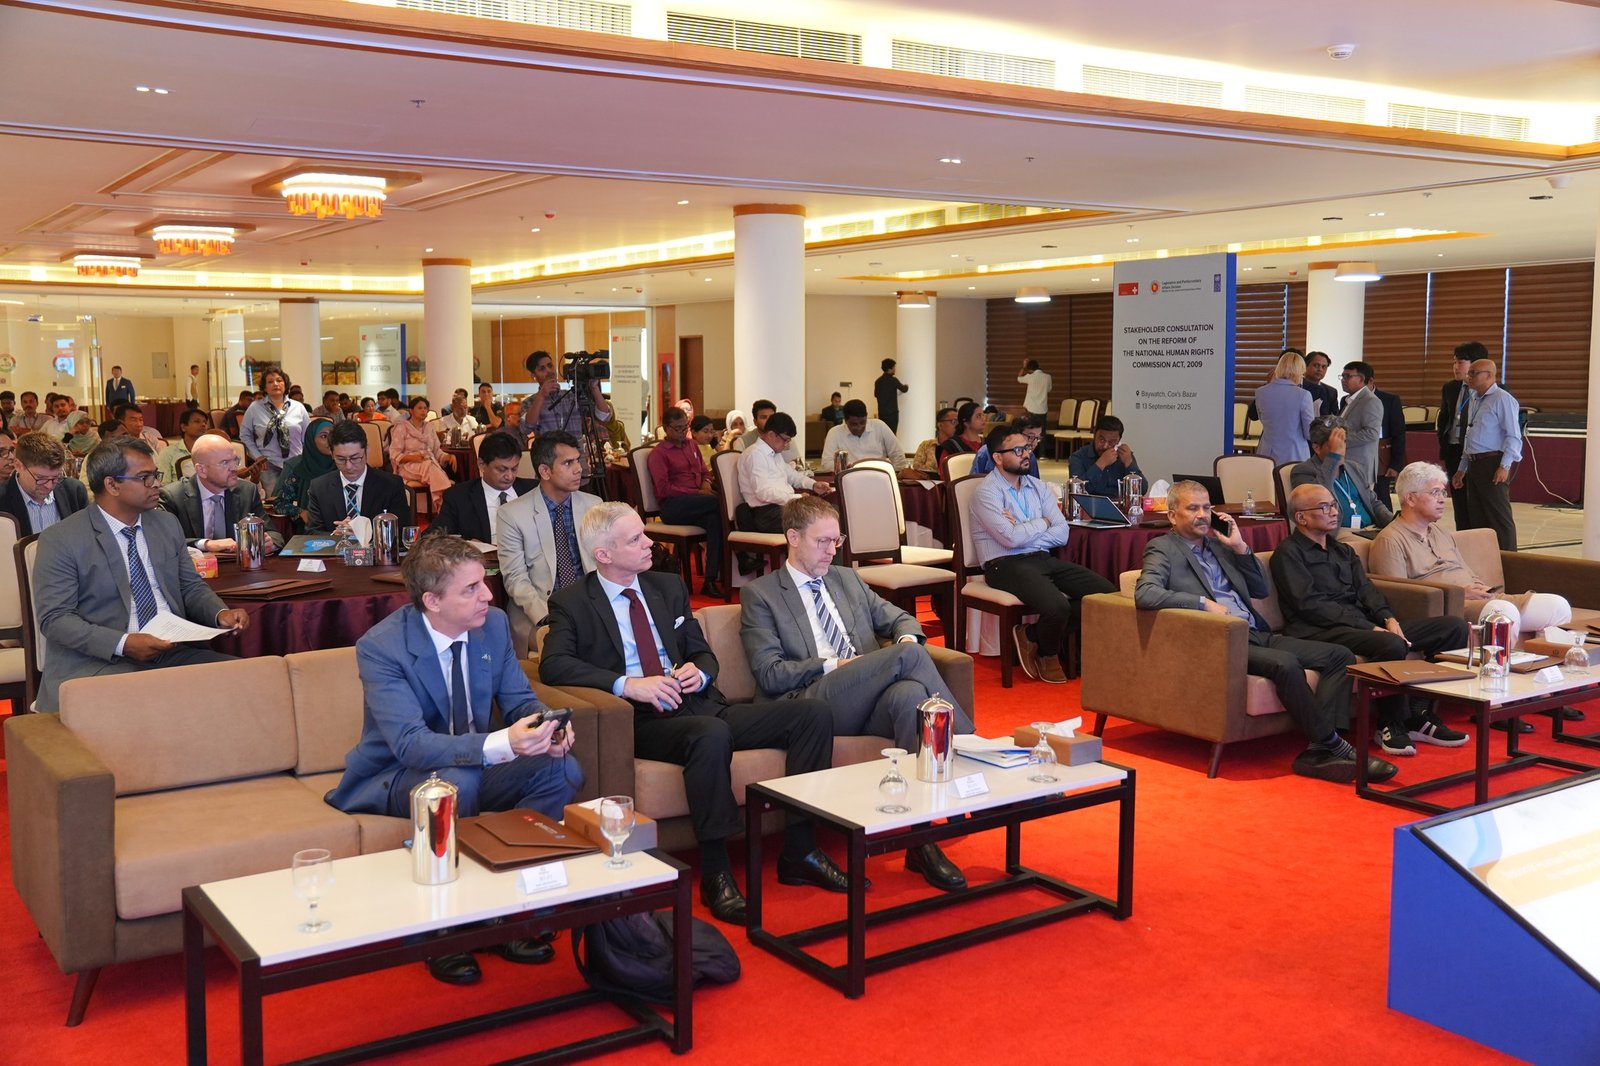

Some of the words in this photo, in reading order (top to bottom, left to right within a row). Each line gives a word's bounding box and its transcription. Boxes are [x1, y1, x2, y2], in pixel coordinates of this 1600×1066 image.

[1166, 324, 1213, 332] CONSULTATION
[1135, 349, 1164, 357] NATIONAL
[1190, 348, 1214, 356] RIGHTS
[1186, 360, 1203, 368] 2009
